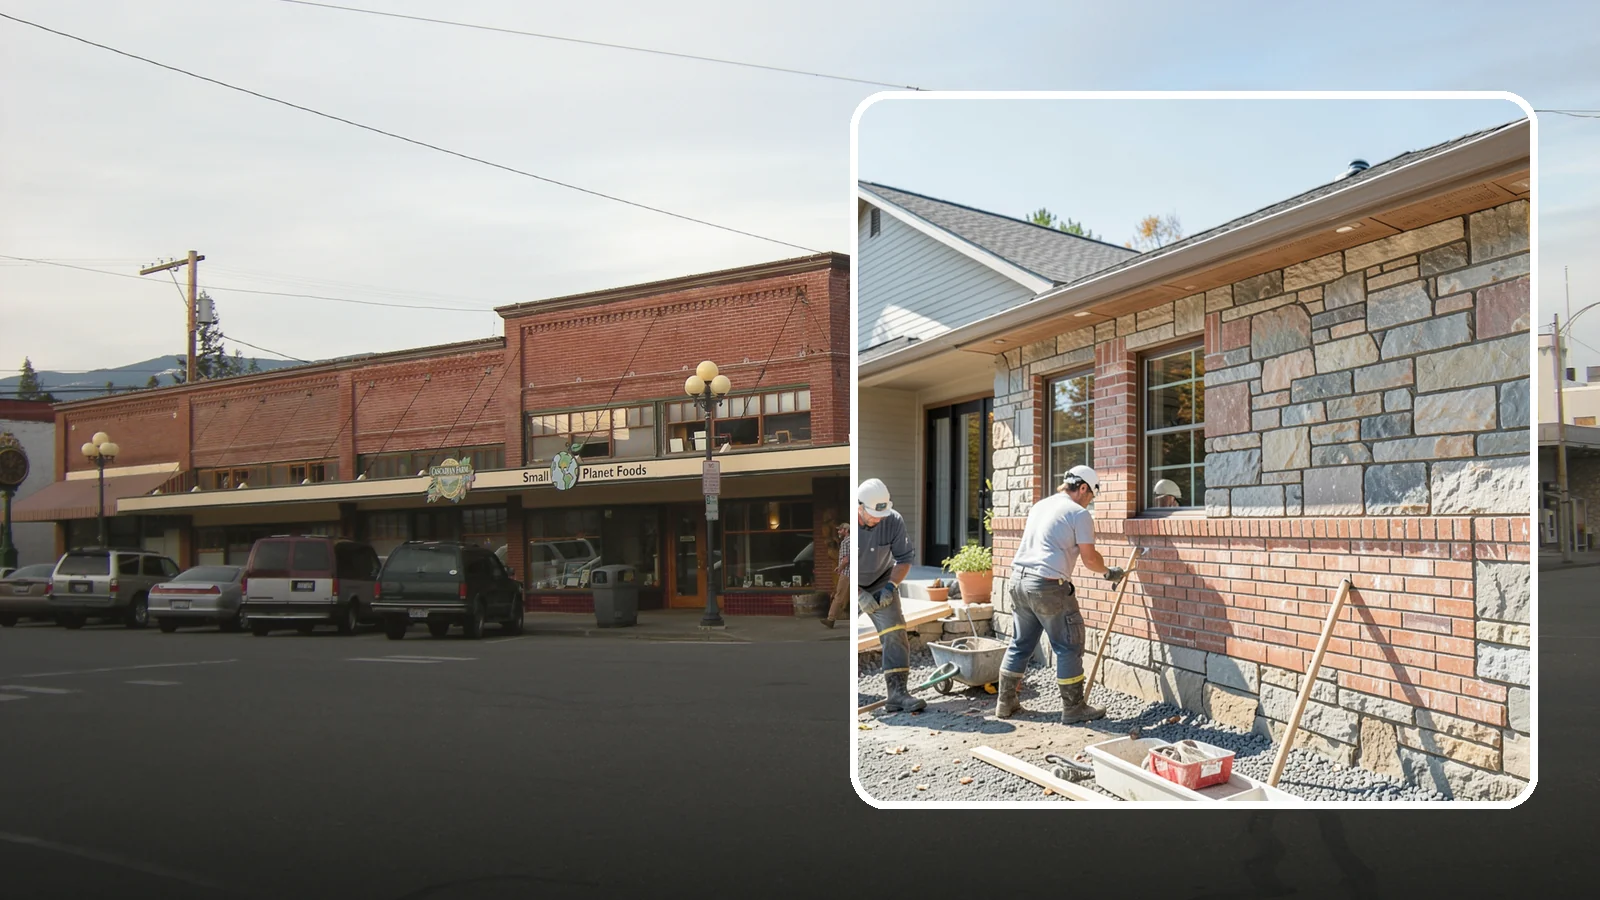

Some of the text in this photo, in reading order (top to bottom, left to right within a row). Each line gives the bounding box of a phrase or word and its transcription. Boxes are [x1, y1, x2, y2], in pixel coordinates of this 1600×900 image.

[523, 464, 647, 483] Small Planet Foods
